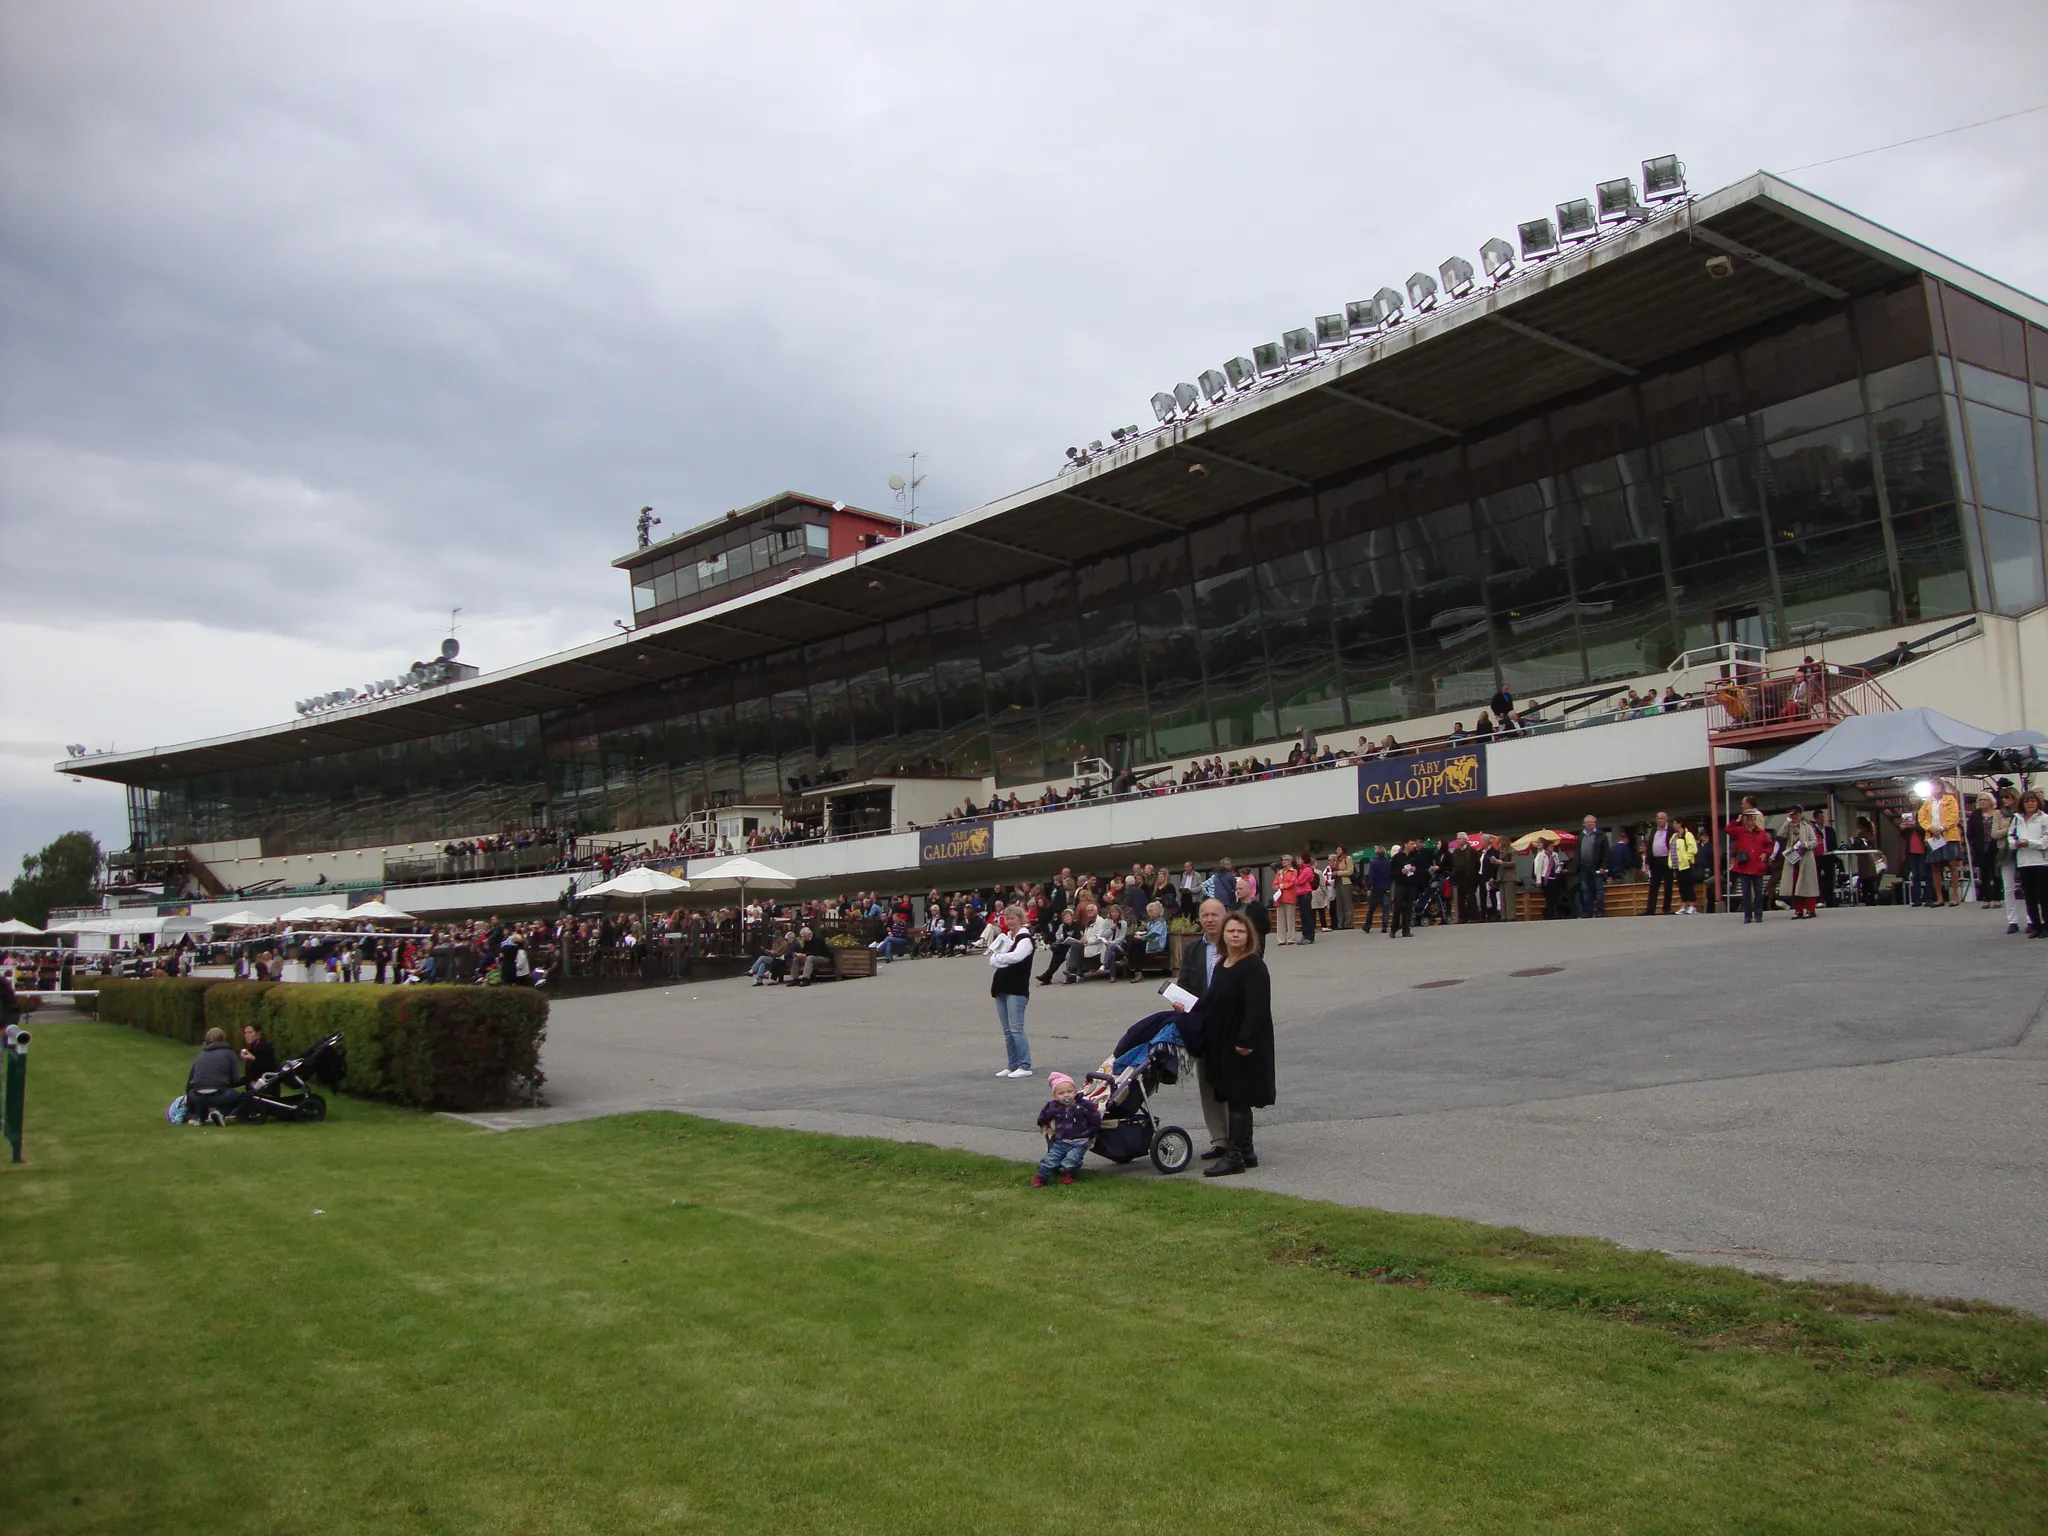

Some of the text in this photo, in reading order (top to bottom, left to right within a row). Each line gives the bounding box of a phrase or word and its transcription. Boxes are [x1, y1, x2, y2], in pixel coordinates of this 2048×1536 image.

[1411, 761, 1440, 776] TÄBY
[1366, 775, 1443, 805] GALOPP
[923, 841, 969, 861] GALOPP
